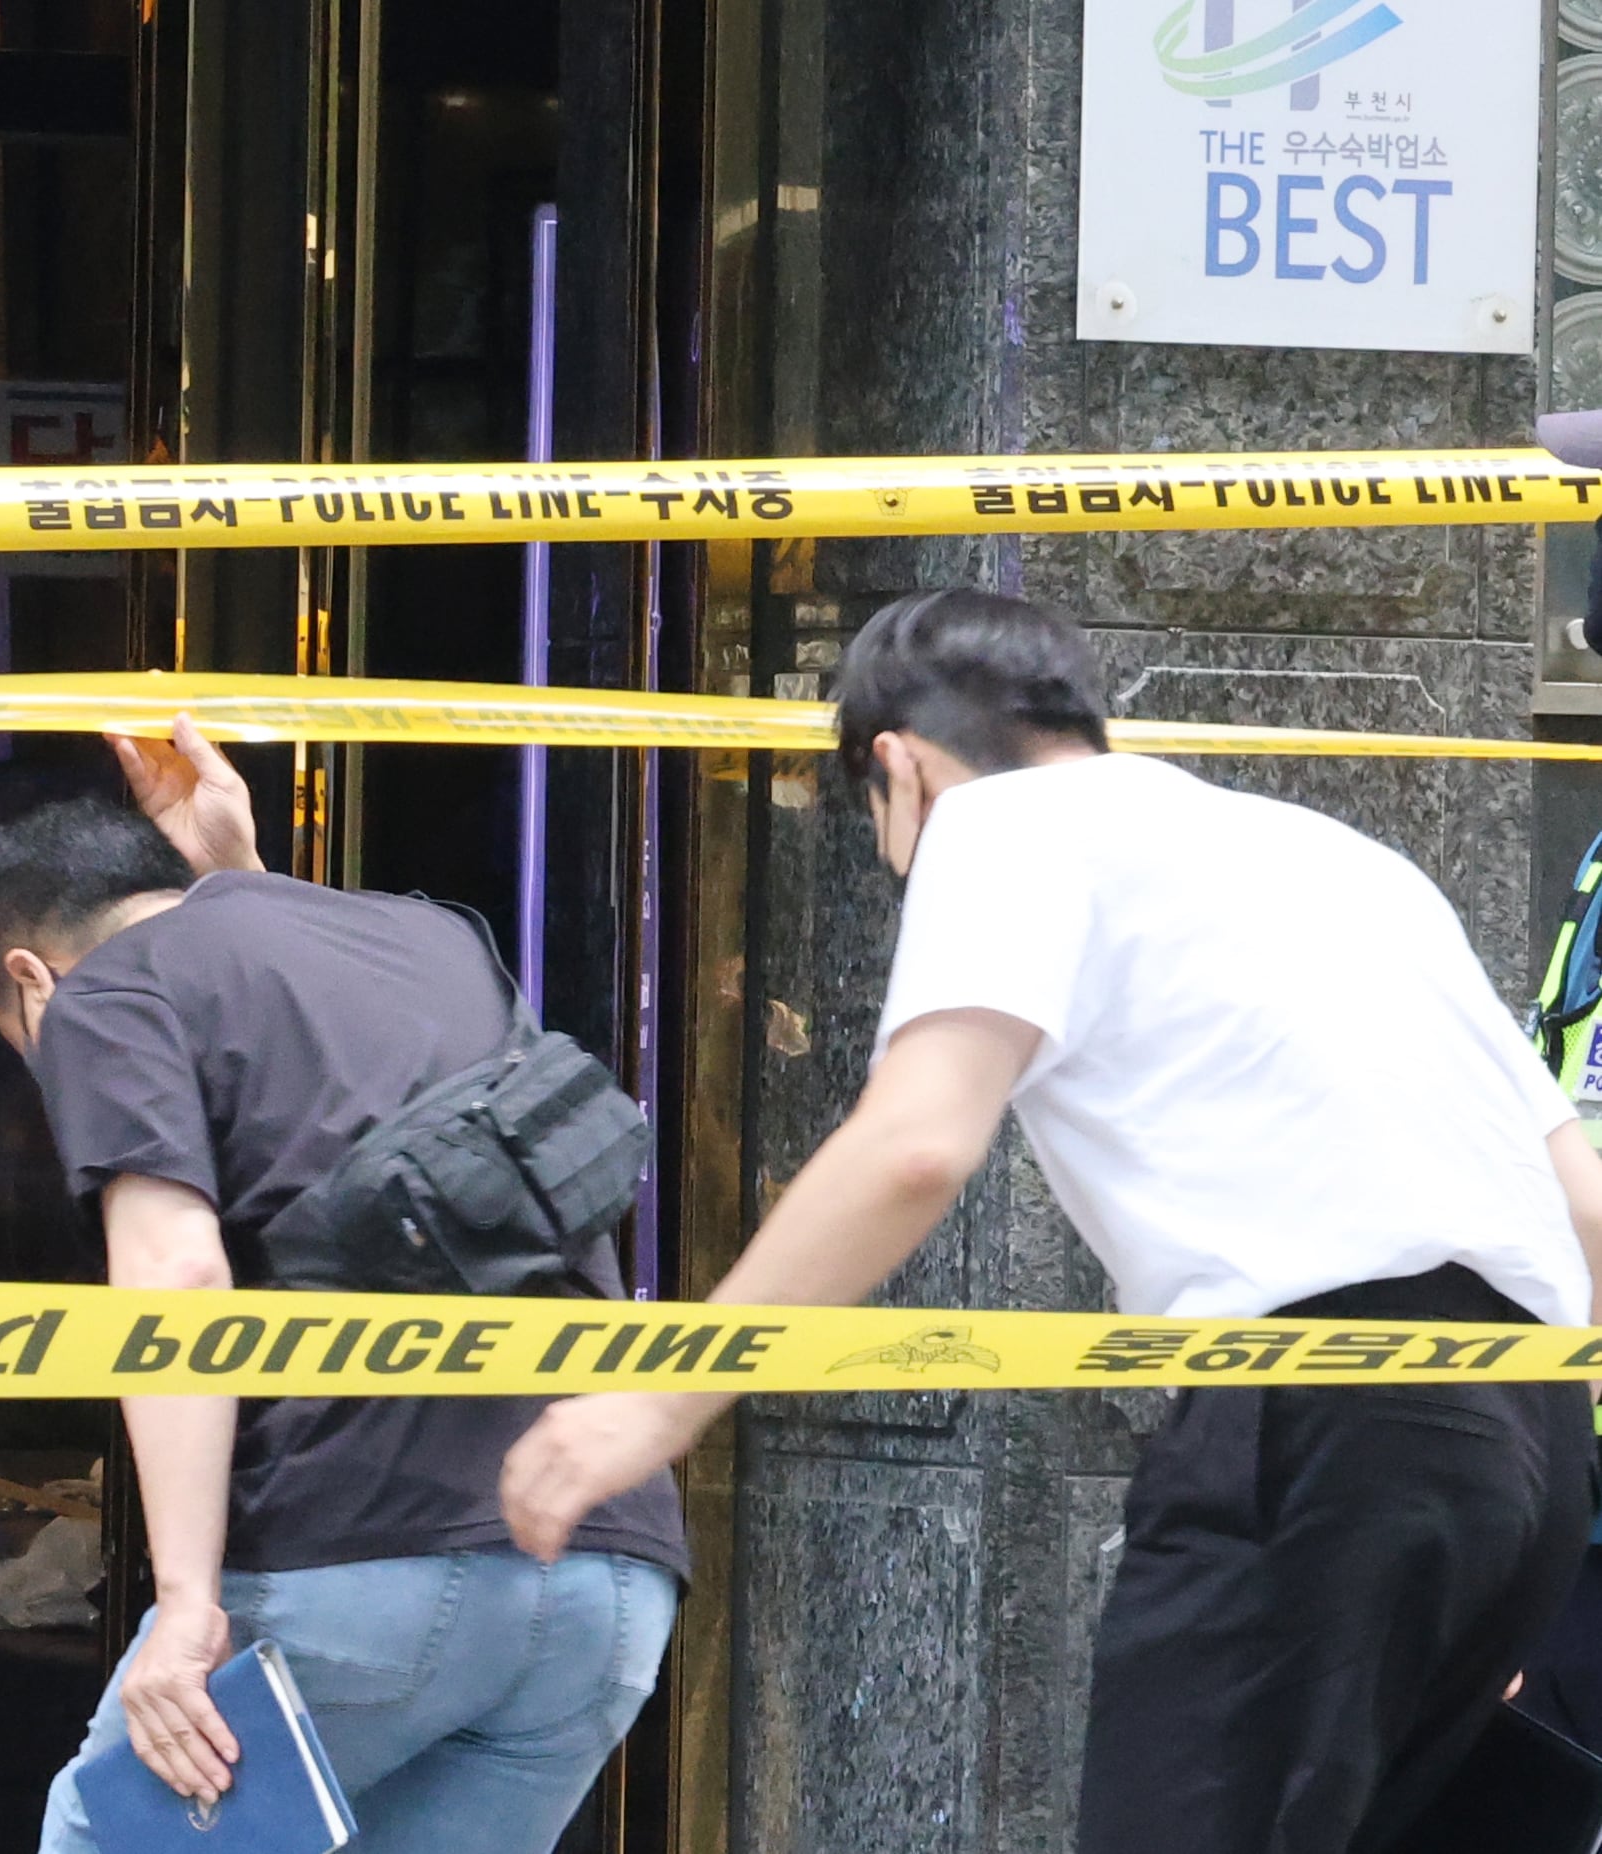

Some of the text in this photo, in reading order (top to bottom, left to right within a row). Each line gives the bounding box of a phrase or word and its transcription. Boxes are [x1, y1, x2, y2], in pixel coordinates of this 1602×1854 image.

[1344, 91, 1411, 112] 부천시
[1199, 131, 1265, 165] THE
[1282, 130, 1448, 169] 우수숙박업소
[1204, 172, 1453, 286] BEST
